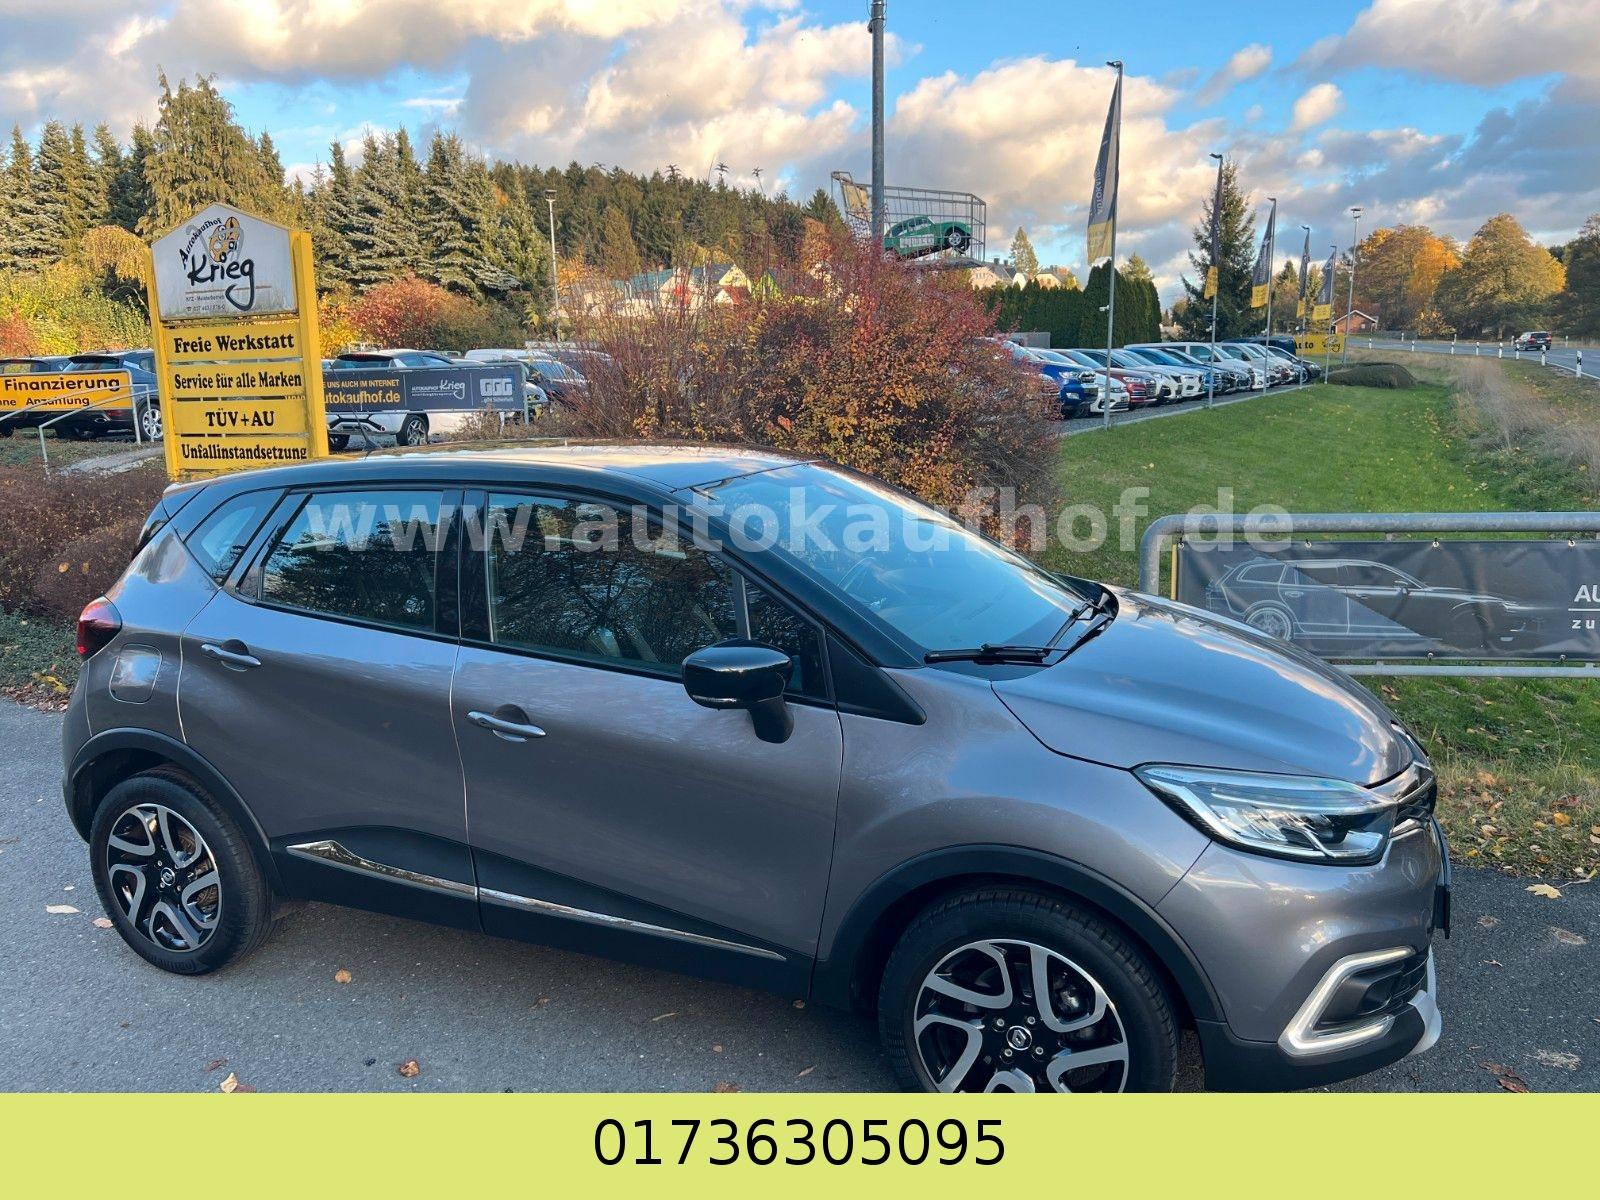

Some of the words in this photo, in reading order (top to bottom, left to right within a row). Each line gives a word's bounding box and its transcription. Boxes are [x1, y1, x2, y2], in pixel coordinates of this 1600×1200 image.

[179, 217, 222, 270] Autokaufhof
[187, 251, 255, 312] Krieg
[174, 337, 212, 353] Freie
[215, 333, 295, 351] Werkstatt
[4, 376, 120, 392] Finanzierung
[174, 373, 214, 389] Service
[216, 373, 233, 388] für
[236, 372, 256, 388] alle
[258, 371, 303, 387] Marken
[369, 379, 400, 387] INTERNET
[439, 379, 466, 400] Krieg
[205, 408, 275, 427] TÜV+AU
[181, 444, 307, 460] Unfallinstandsetzung
